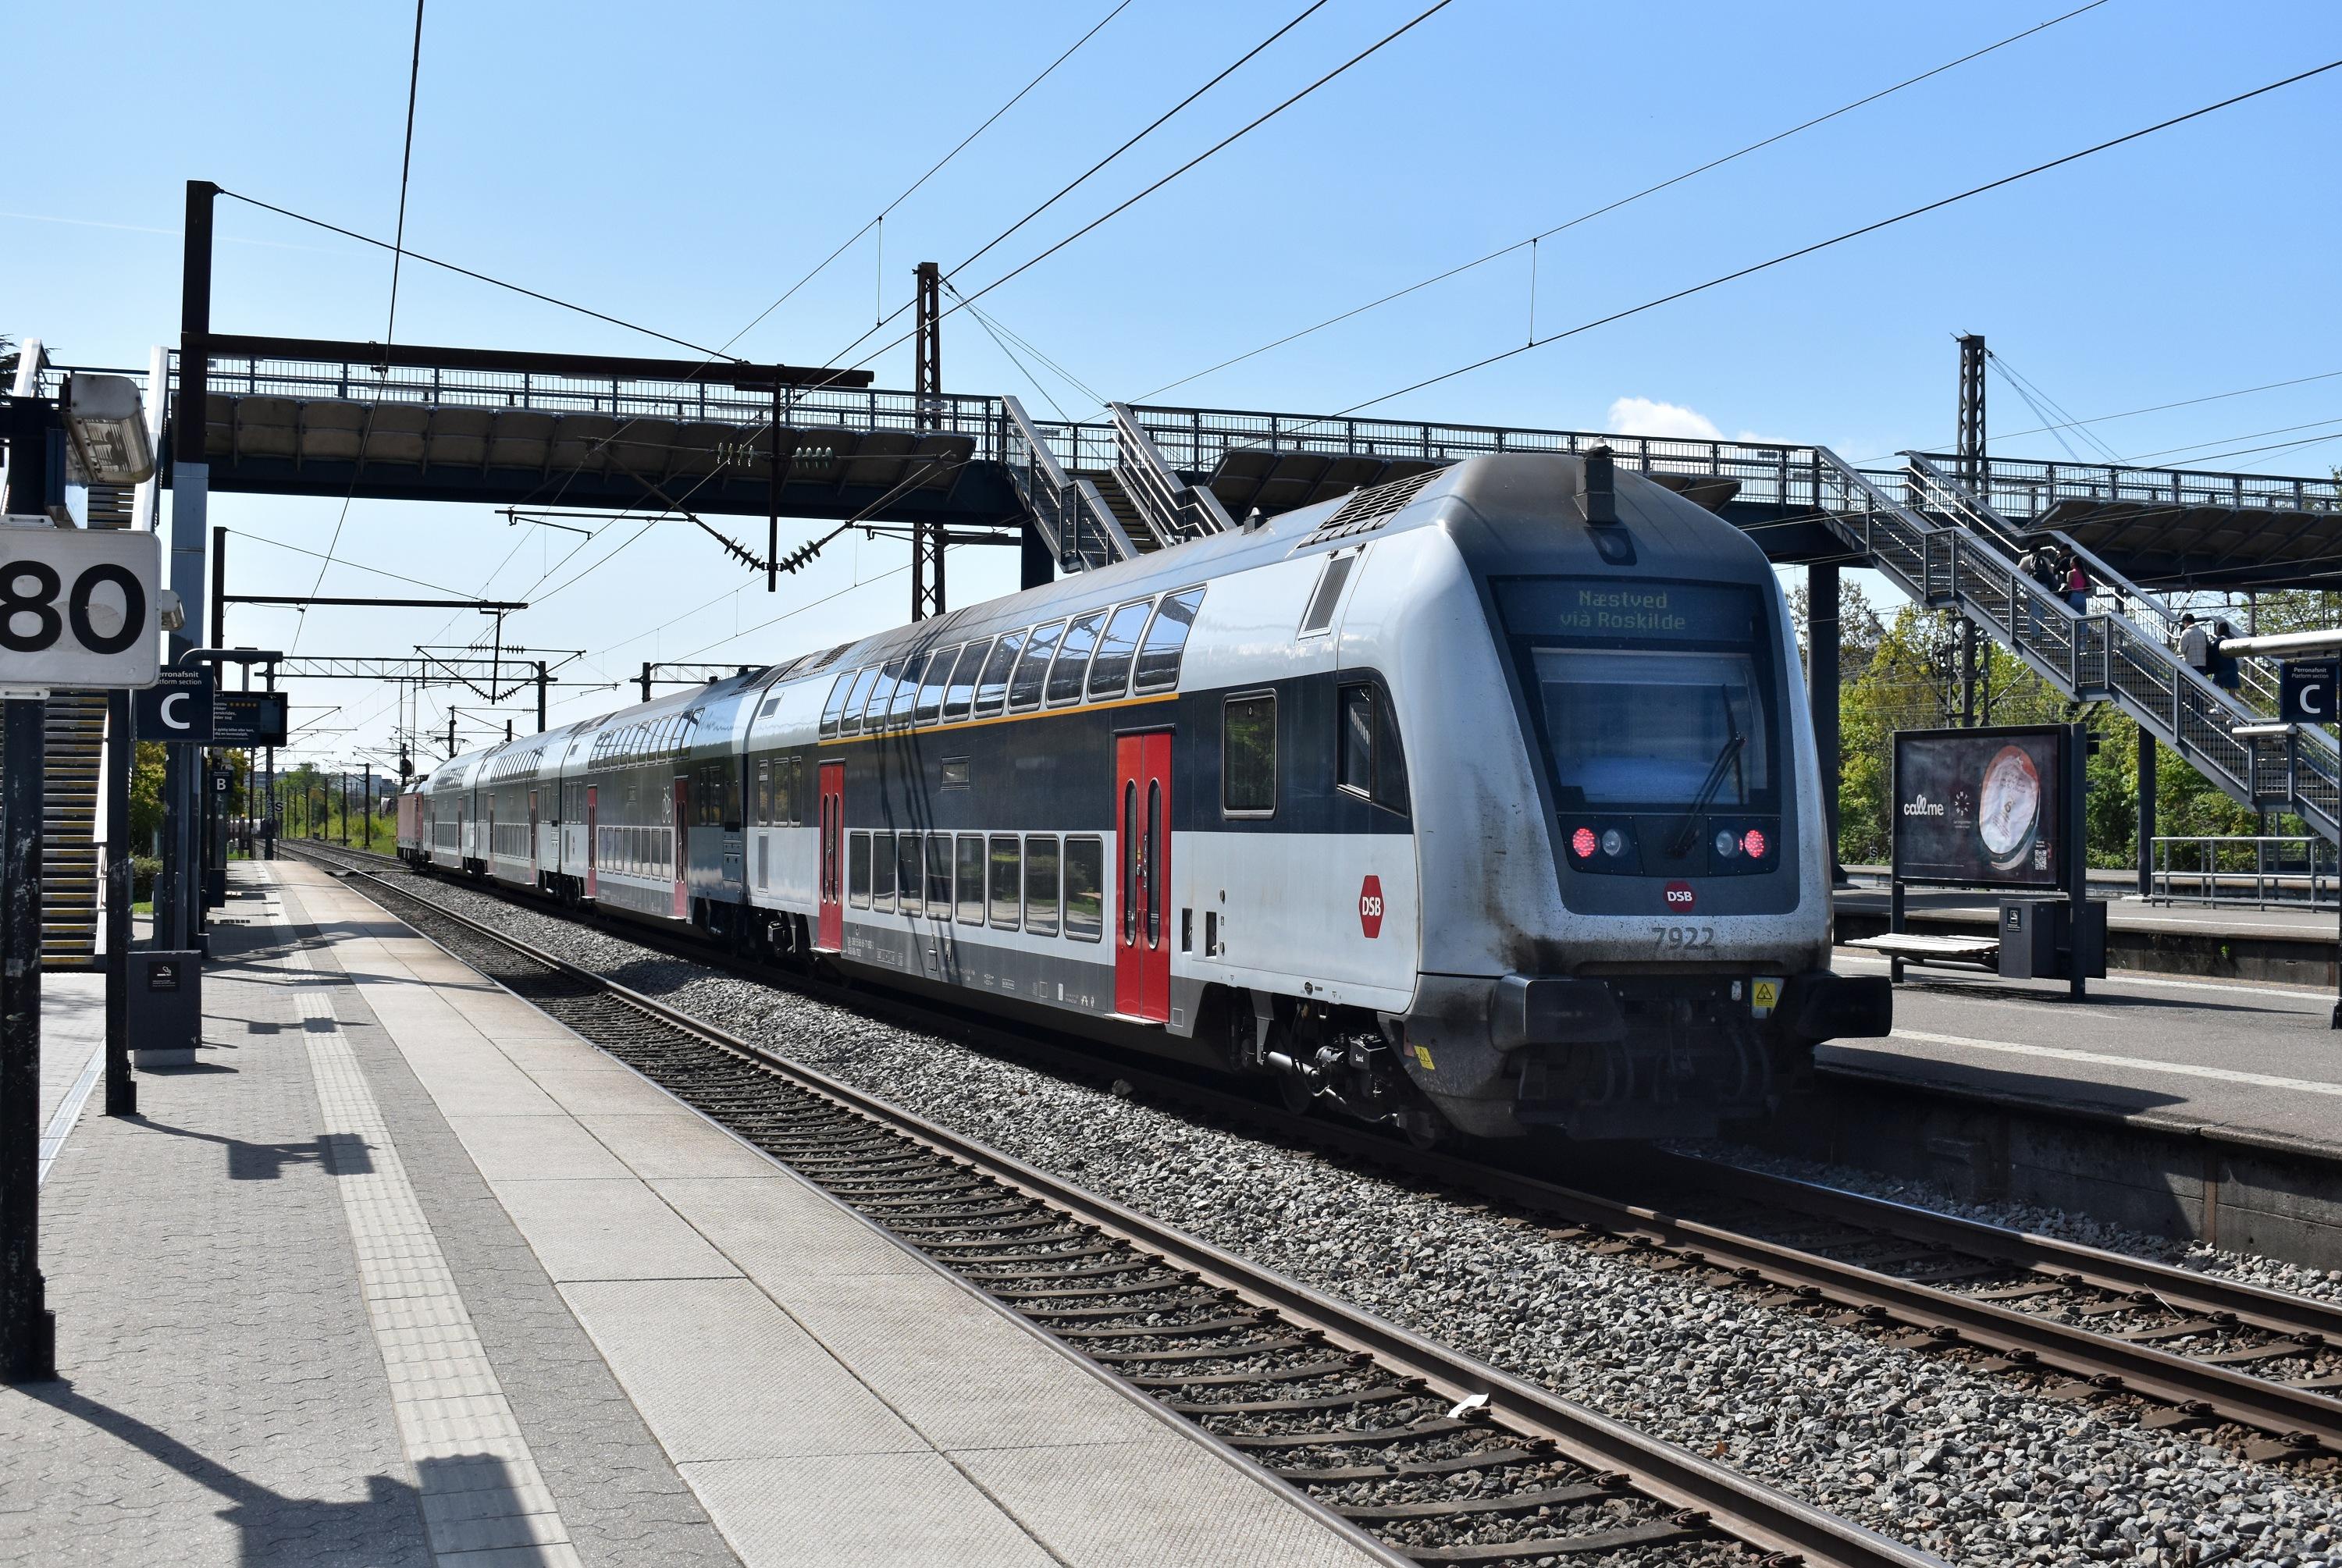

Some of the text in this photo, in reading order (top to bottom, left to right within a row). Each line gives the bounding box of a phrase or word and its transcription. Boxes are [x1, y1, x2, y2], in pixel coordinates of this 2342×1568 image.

[0, 560, 146, 654] 80
[1579, 590, 1667, 609] Næstved
[1598, 612, 1686, 630] Roskilde
[2299, 684, 2321, 714] C
[161, 692, 190, 730] C
[216, 778, 226, 791] B
[275, 802, 283, 812] S
[1870, 848, 1878, 858] S
[1667, 891, 1693, 901] DSB
[1361, 897, 1381, 916] DSB
[1651, 926, 1715, 951] 7922
